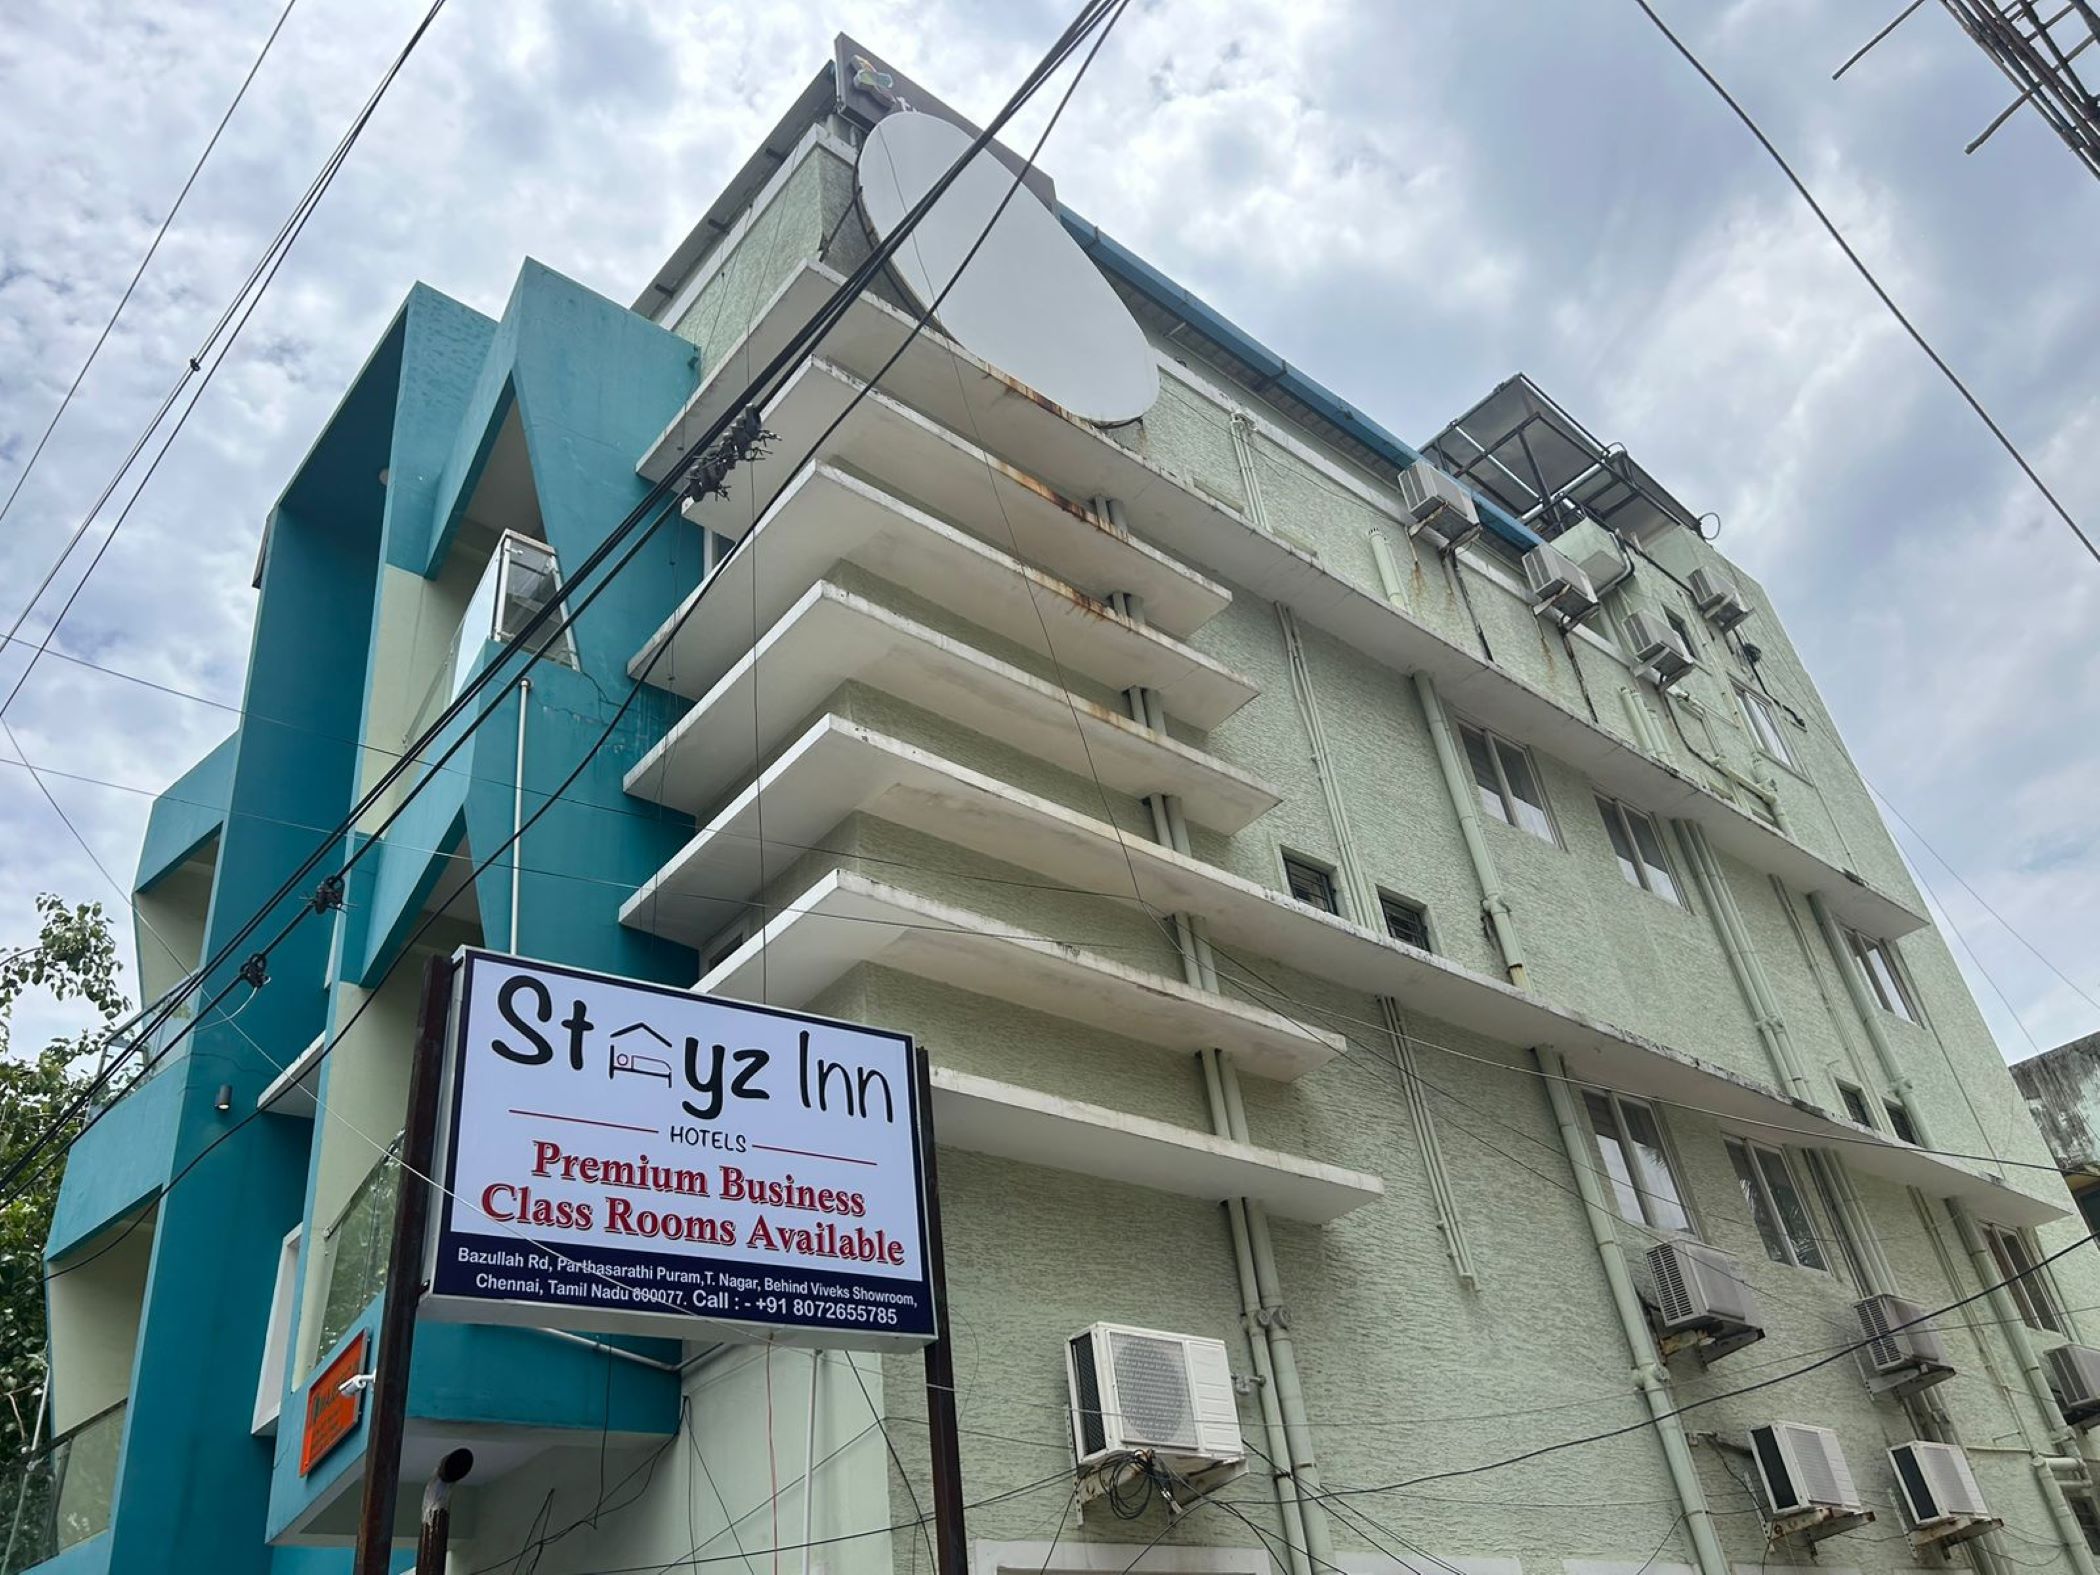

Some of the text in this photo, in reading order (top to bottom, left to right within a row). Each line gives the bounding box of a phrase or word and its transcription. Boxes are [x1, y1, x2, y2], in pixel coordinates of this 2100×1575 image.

[799, 1030, 894, 1123] Inn
[670, 1125, 747, 1153] HOTELS
[531, 1139, 866, 1216] Premium Business
[481, 1182, 906, 1265] Class Rooms Available
[457, 1247, 525, 1270] Bazullah
[528, 1254, 553, 1272] Rd,
[556, 1256, 654, 1280] Parthasarathi
[719, 1273, 761, 1292] Nagar,
[764, 1278, 808, 1295] Behind
[810, 1283, 850, 1299] Viveks
[852, 1286, 918, 1308] Showroom,
[475, 1273, 544, 1296] Chennai,
[547, 1280, 588, 1297] Tamil
[591, 1284, 629, 1300] Nadu
[693, 1290, 730, 1309] Call
[756, 1297, 788, 1315] +91
[793, 1298, 898, 1325] 8072655785
